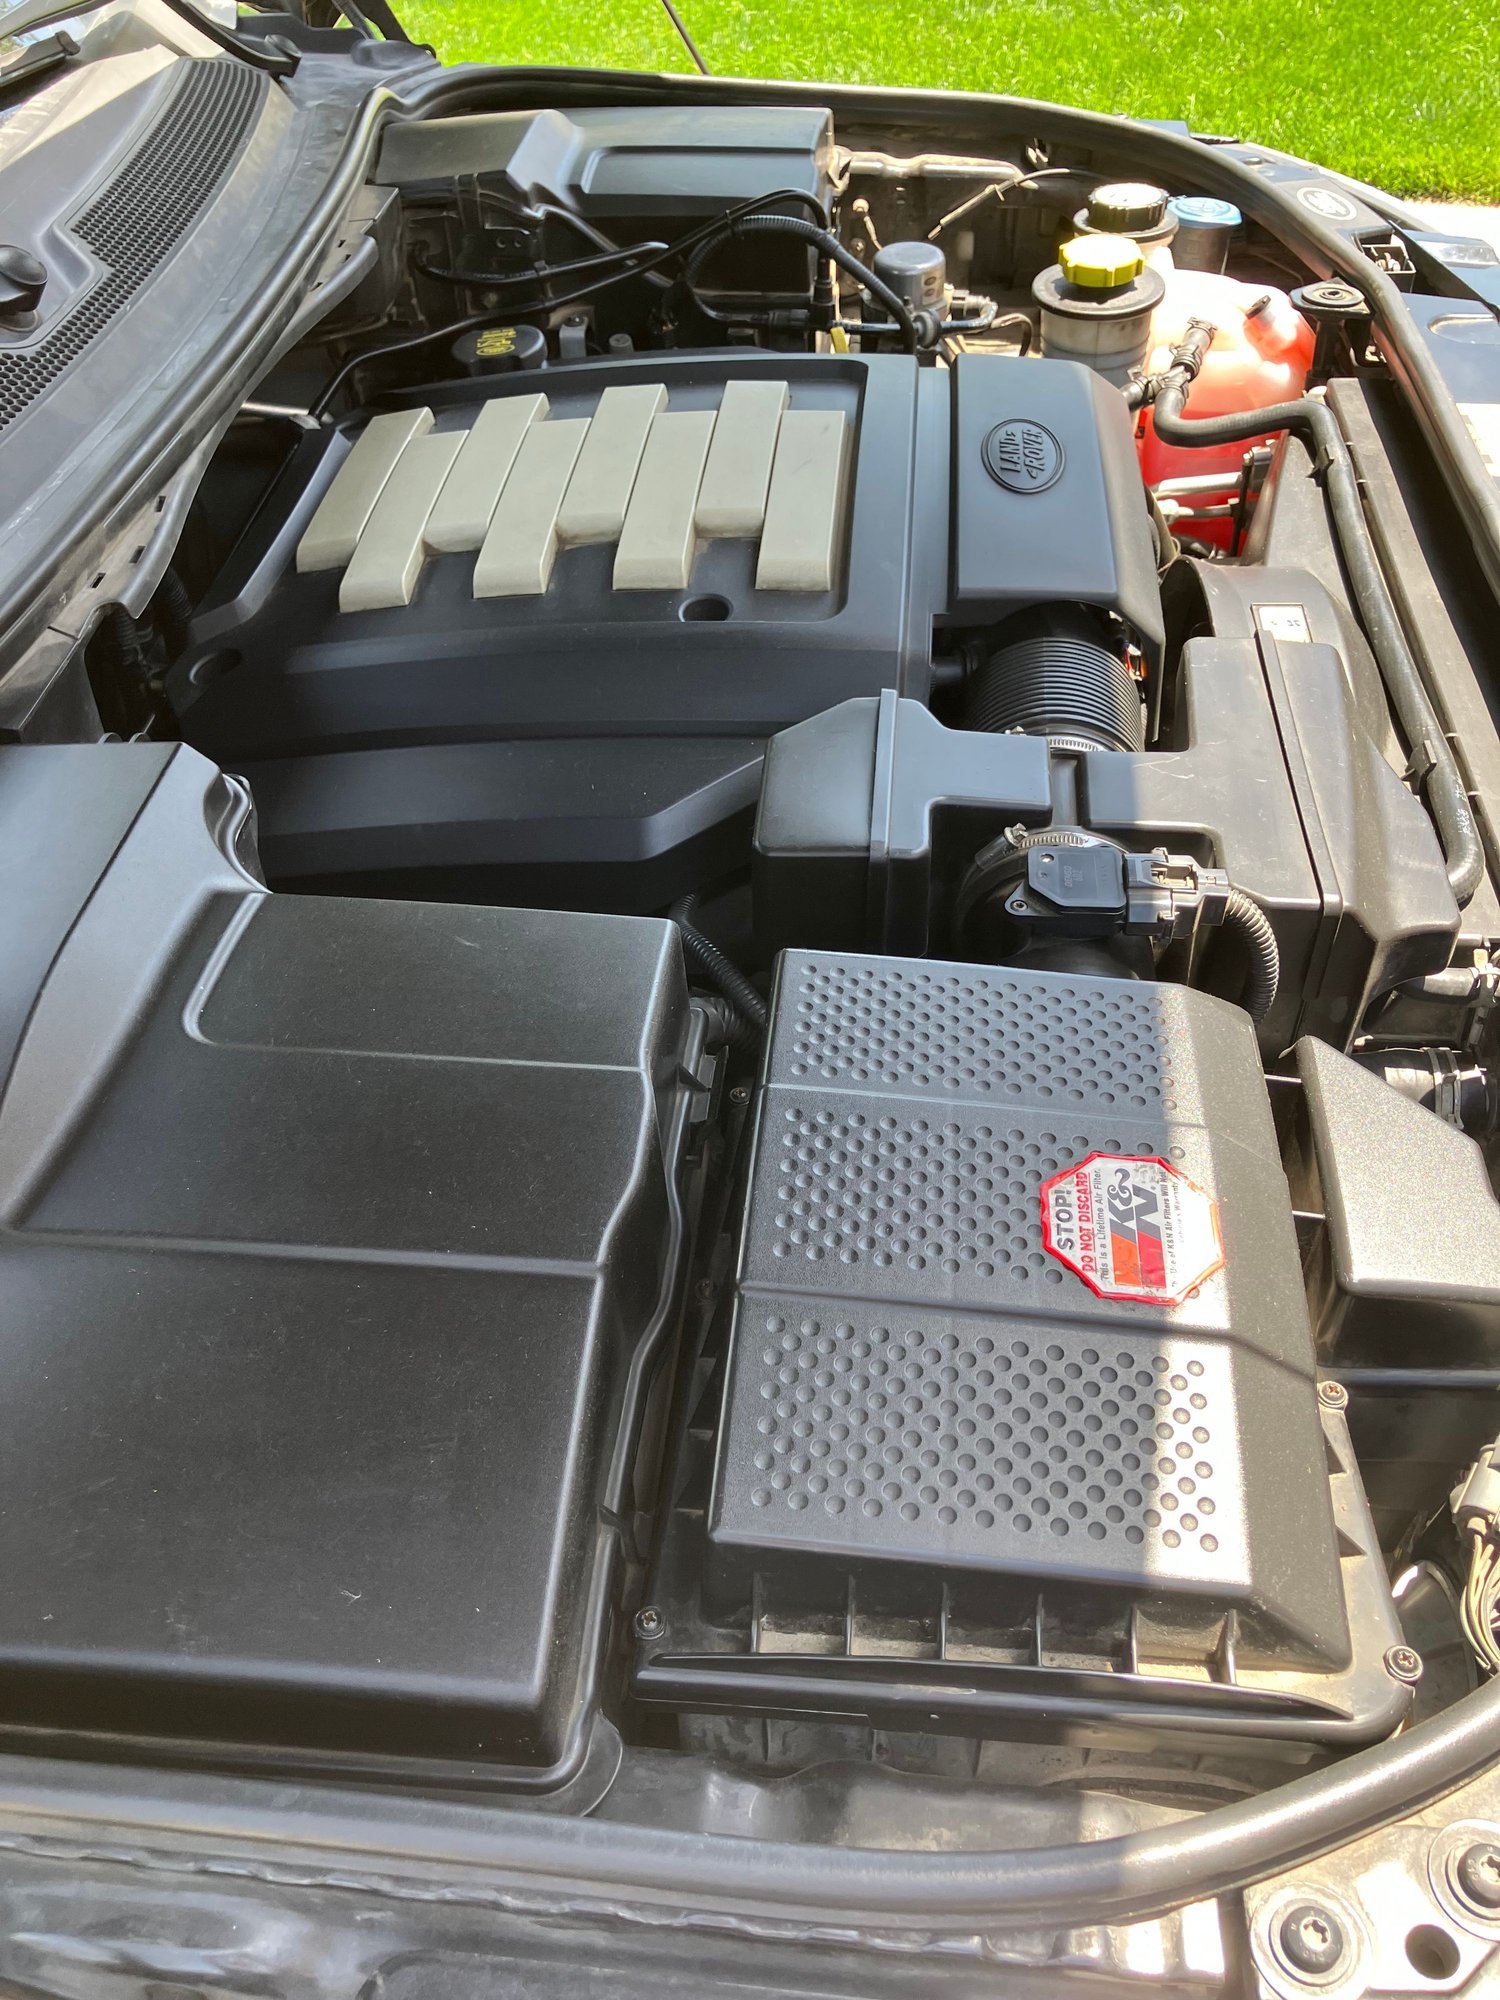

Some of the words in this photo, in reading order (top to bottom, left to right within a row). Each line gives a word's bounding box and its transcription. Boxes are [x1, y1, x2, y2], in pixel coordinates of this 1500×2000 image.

[998, 438, 1022, 472] LAND
[1022, 430, 1045, 472] ROVER
[1063, 865, 1072, 887] DENSO
[1093, 1169, 1102, 1190] Filter.
[1161, 1184, 1169, 1196] Will
[1075, 1172, 1092, 1223] DISCARD
[1094, 1193, 1104, 1204] Air
[1163, 1197, 1172, 1220] Filters
[1054, 1189, 1075, 1251] STOP!
[1096, 1207, 1106, 1240] Lifetime
[1107, 1168, 1166, 1288] K&N
[1165, 1221, 1173, 1232] Air
[1079, 1226, 1095, 1252] NOT
[1167, 1233, 1175, 1249] K&N
[1081, 1255, 1096, 1273] DO
[1099, 1252, 1107, 1260] is
[1168, 1250, 1176, 1258] of
[1100, 1262, 1109, 1280] This
